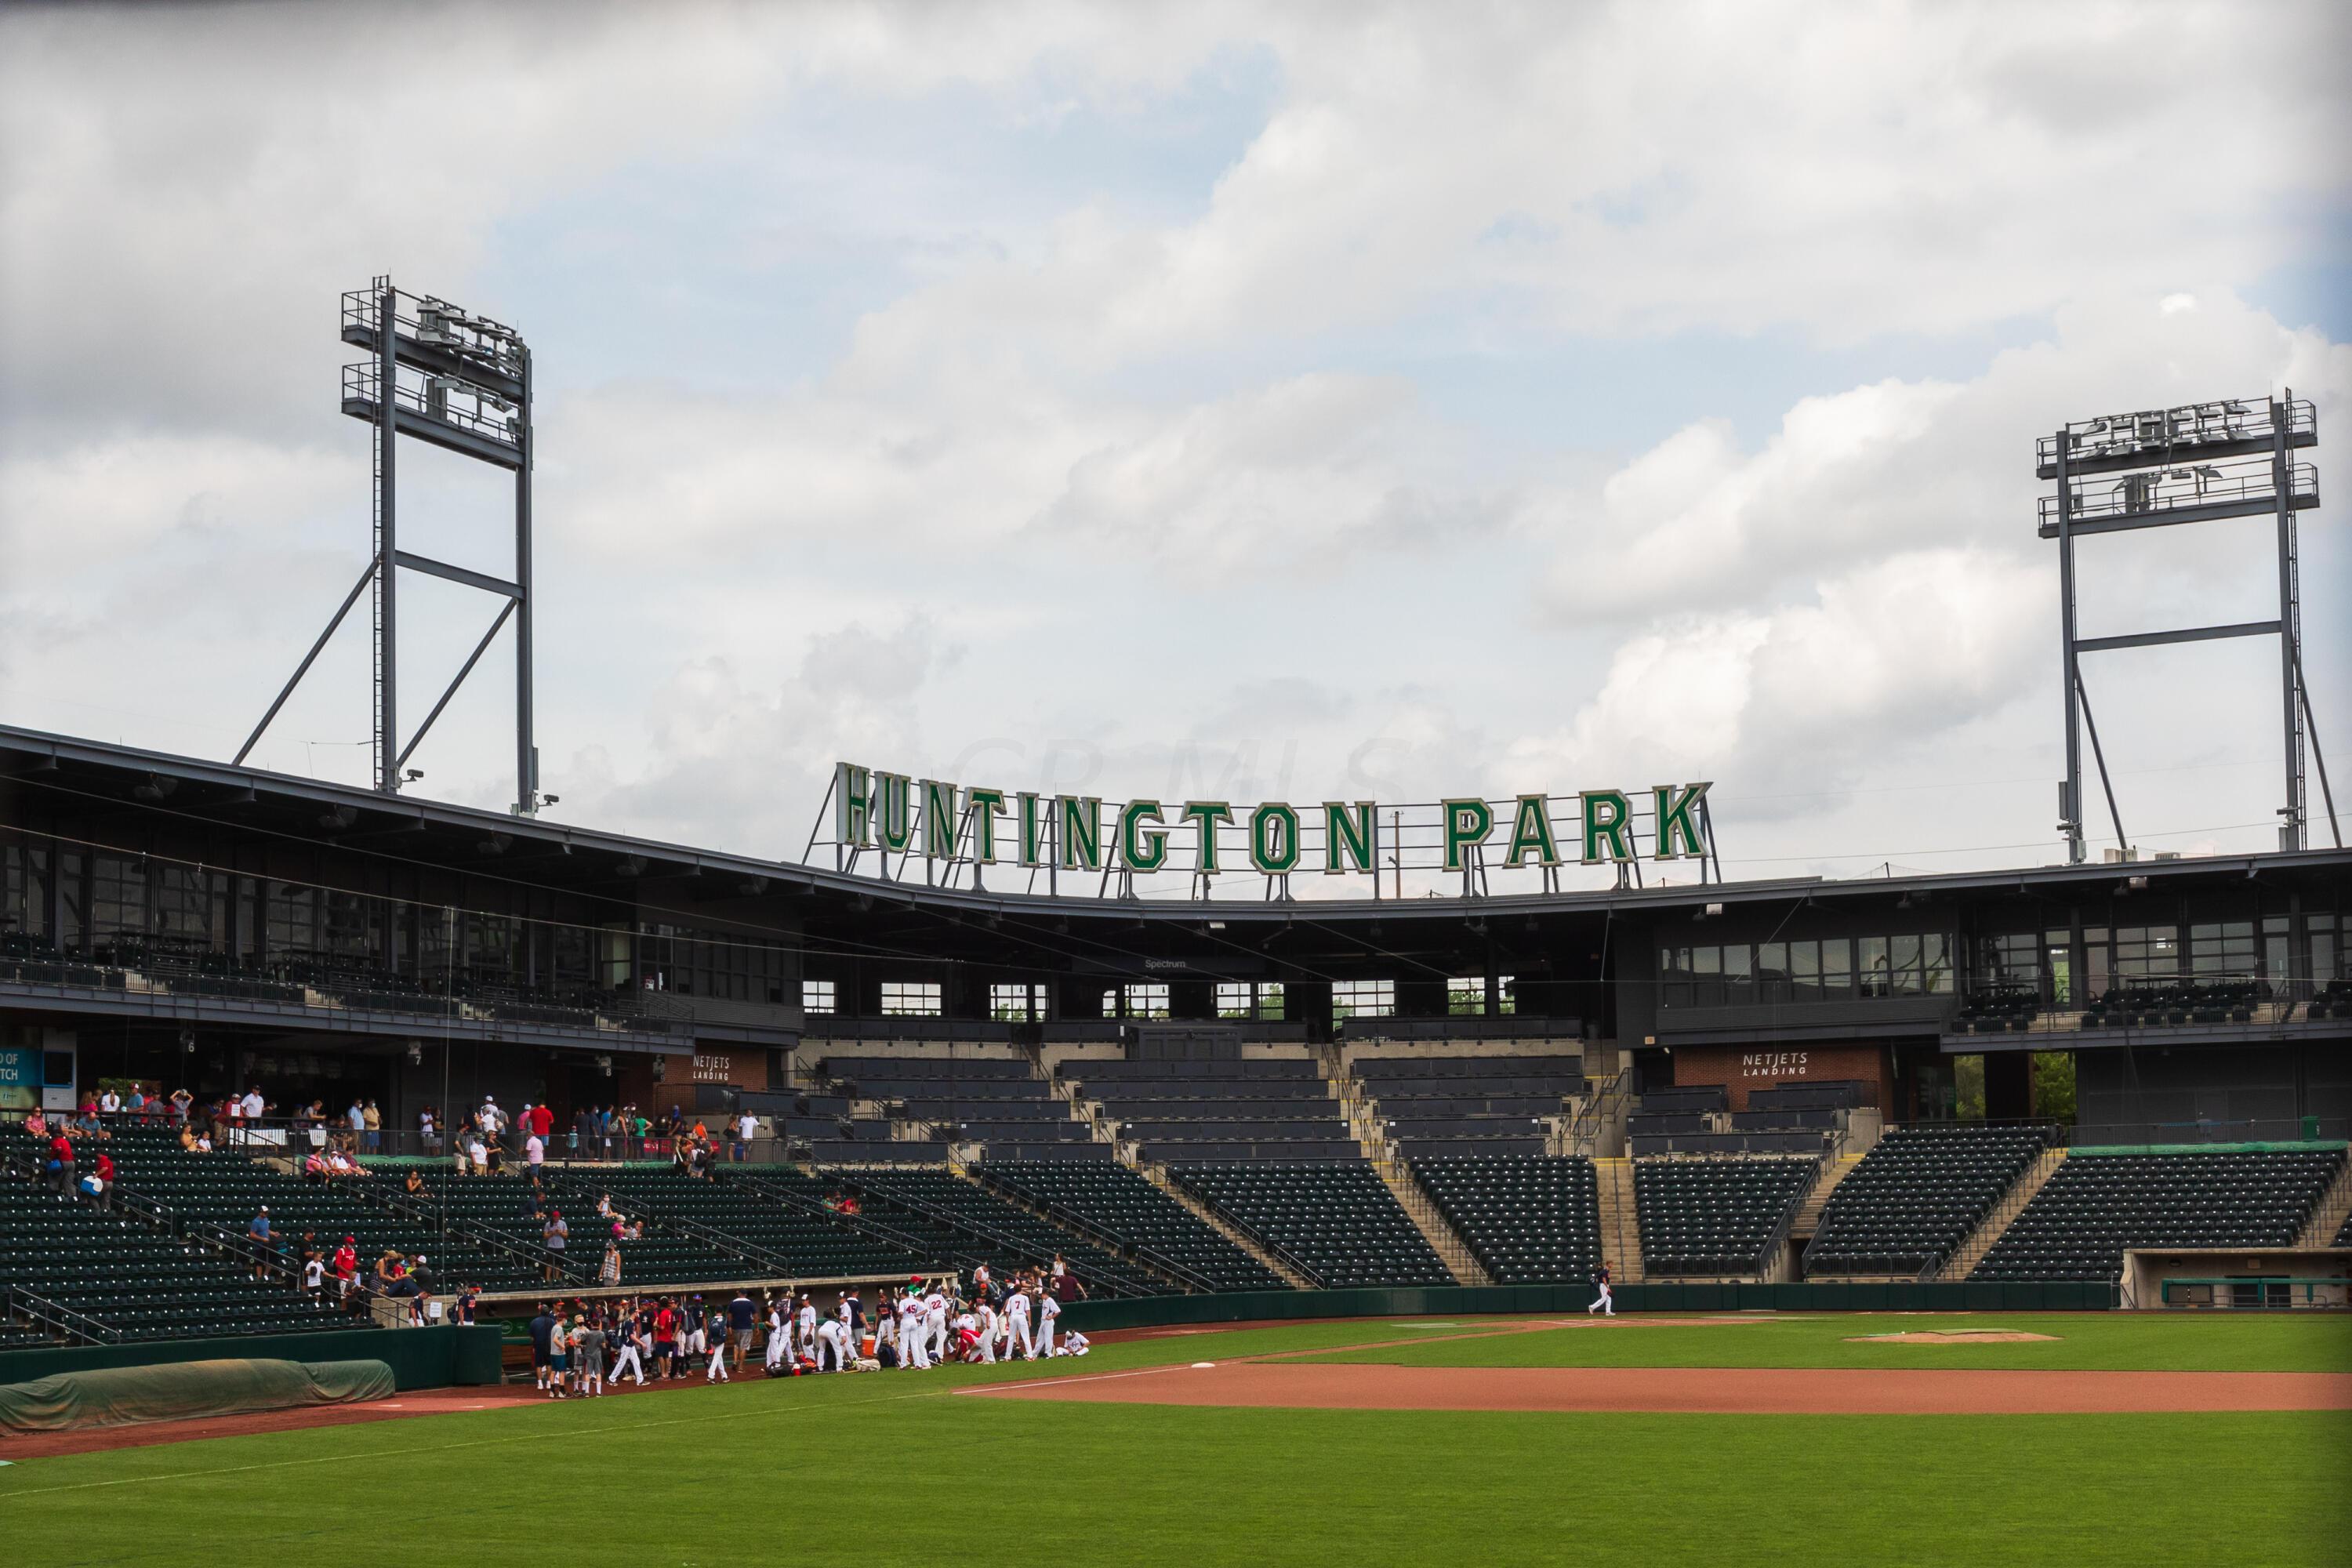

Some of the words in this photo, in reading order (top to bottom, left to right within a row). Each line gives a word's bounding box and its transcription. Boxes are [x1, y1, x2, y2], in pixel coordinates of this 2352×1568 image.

[836, 761, 1376, 876] HUNTINGTON
[1441, 782, 1714, 873] PARK
[1145, 959, 1185, 970] Spectrum
[5, 1053, 19, 1065] OF
[416, 1055, 421, 1065] 7
[693, 1054, 729, 1071] NETJETS
[1743, 1052, 1808, 1068] NETJETS
[0, 1068, 18, 1080] TCH
[693, 1071, 728, 1080] LANDING
[1743, 1067, 1806, 1076] LANDING
[906, 1305, 916, 1314] 45
[931, 1300, 942, 1310] 22
[1014, 1301, 1021, 1309] 7
